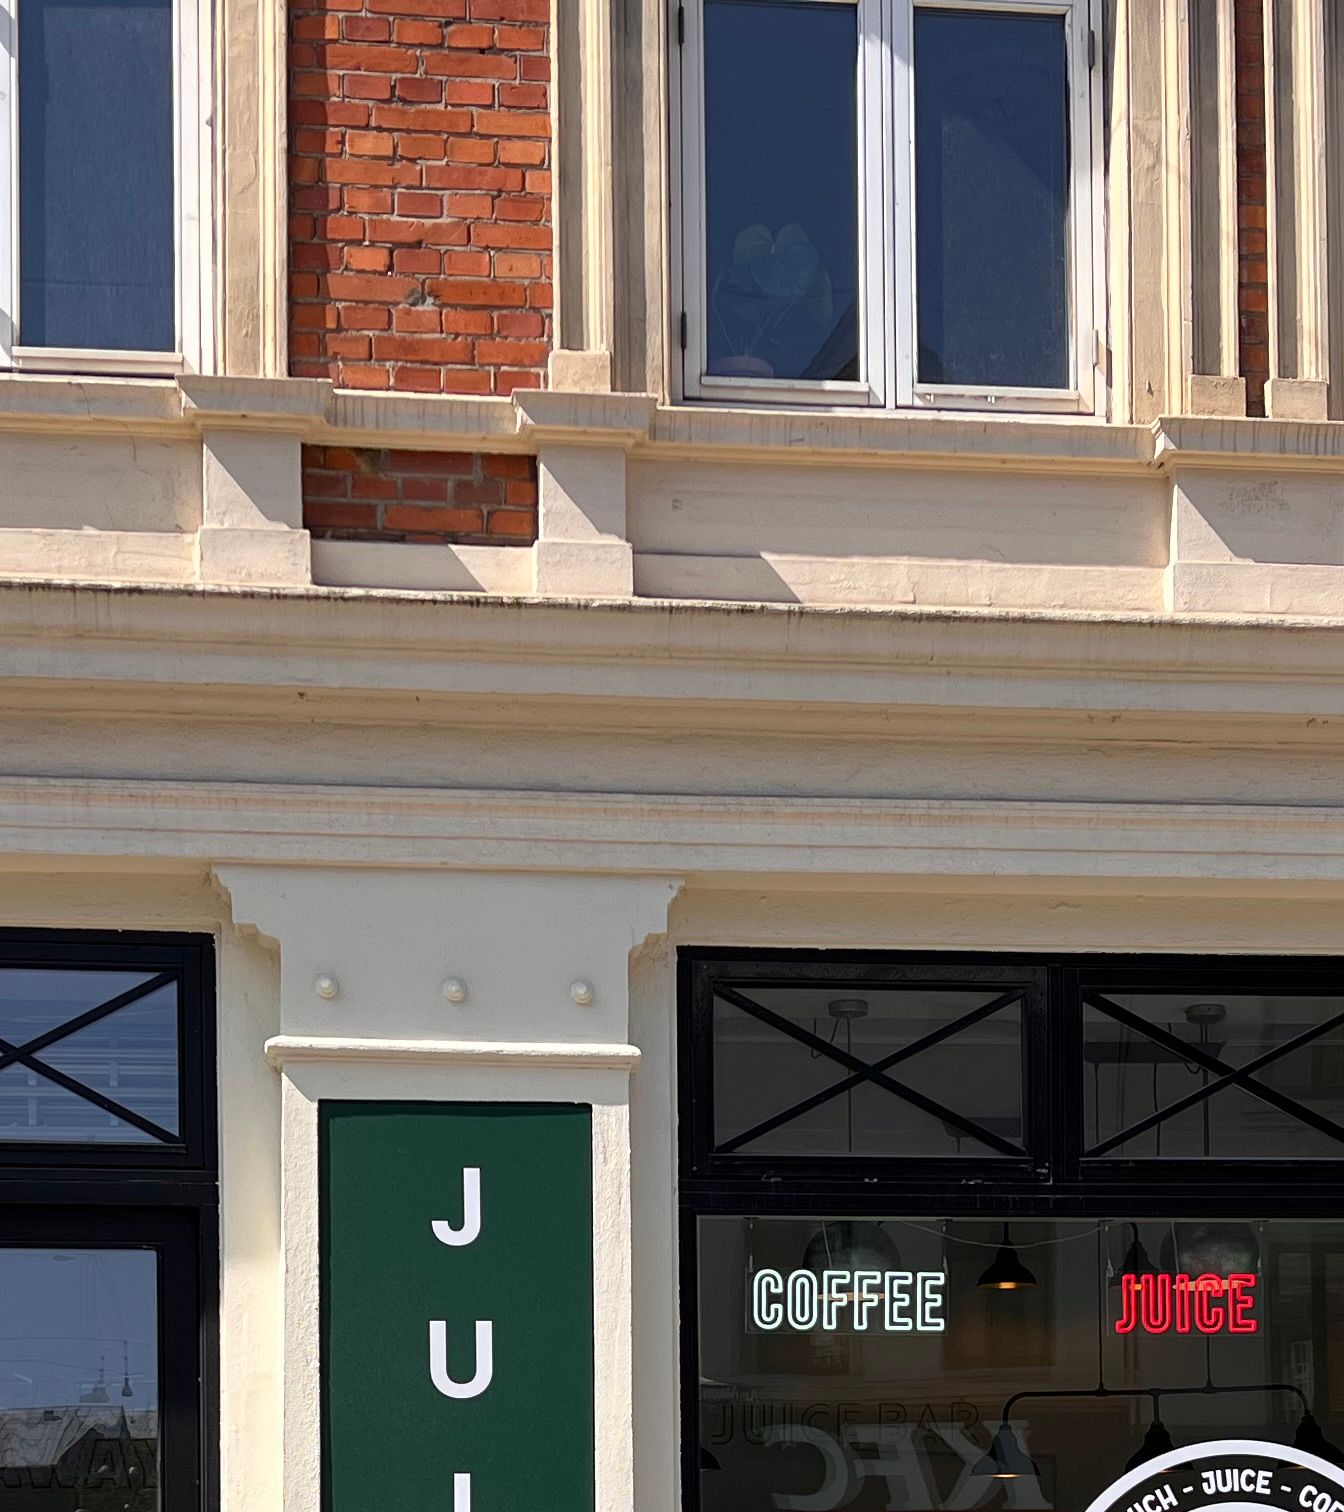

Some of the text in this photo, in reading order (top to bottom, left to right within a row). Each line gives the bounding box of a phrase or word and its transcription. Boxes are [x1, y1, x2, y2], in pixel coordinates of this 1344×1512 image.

[752, 1267, 947, 1333] COFFEE
[1115, 1272, 1258, 1335] JUICE
[712, 1401, 983, 1445] JUICE BAR
[1201, 1468, 1273, 1495] JUICE
